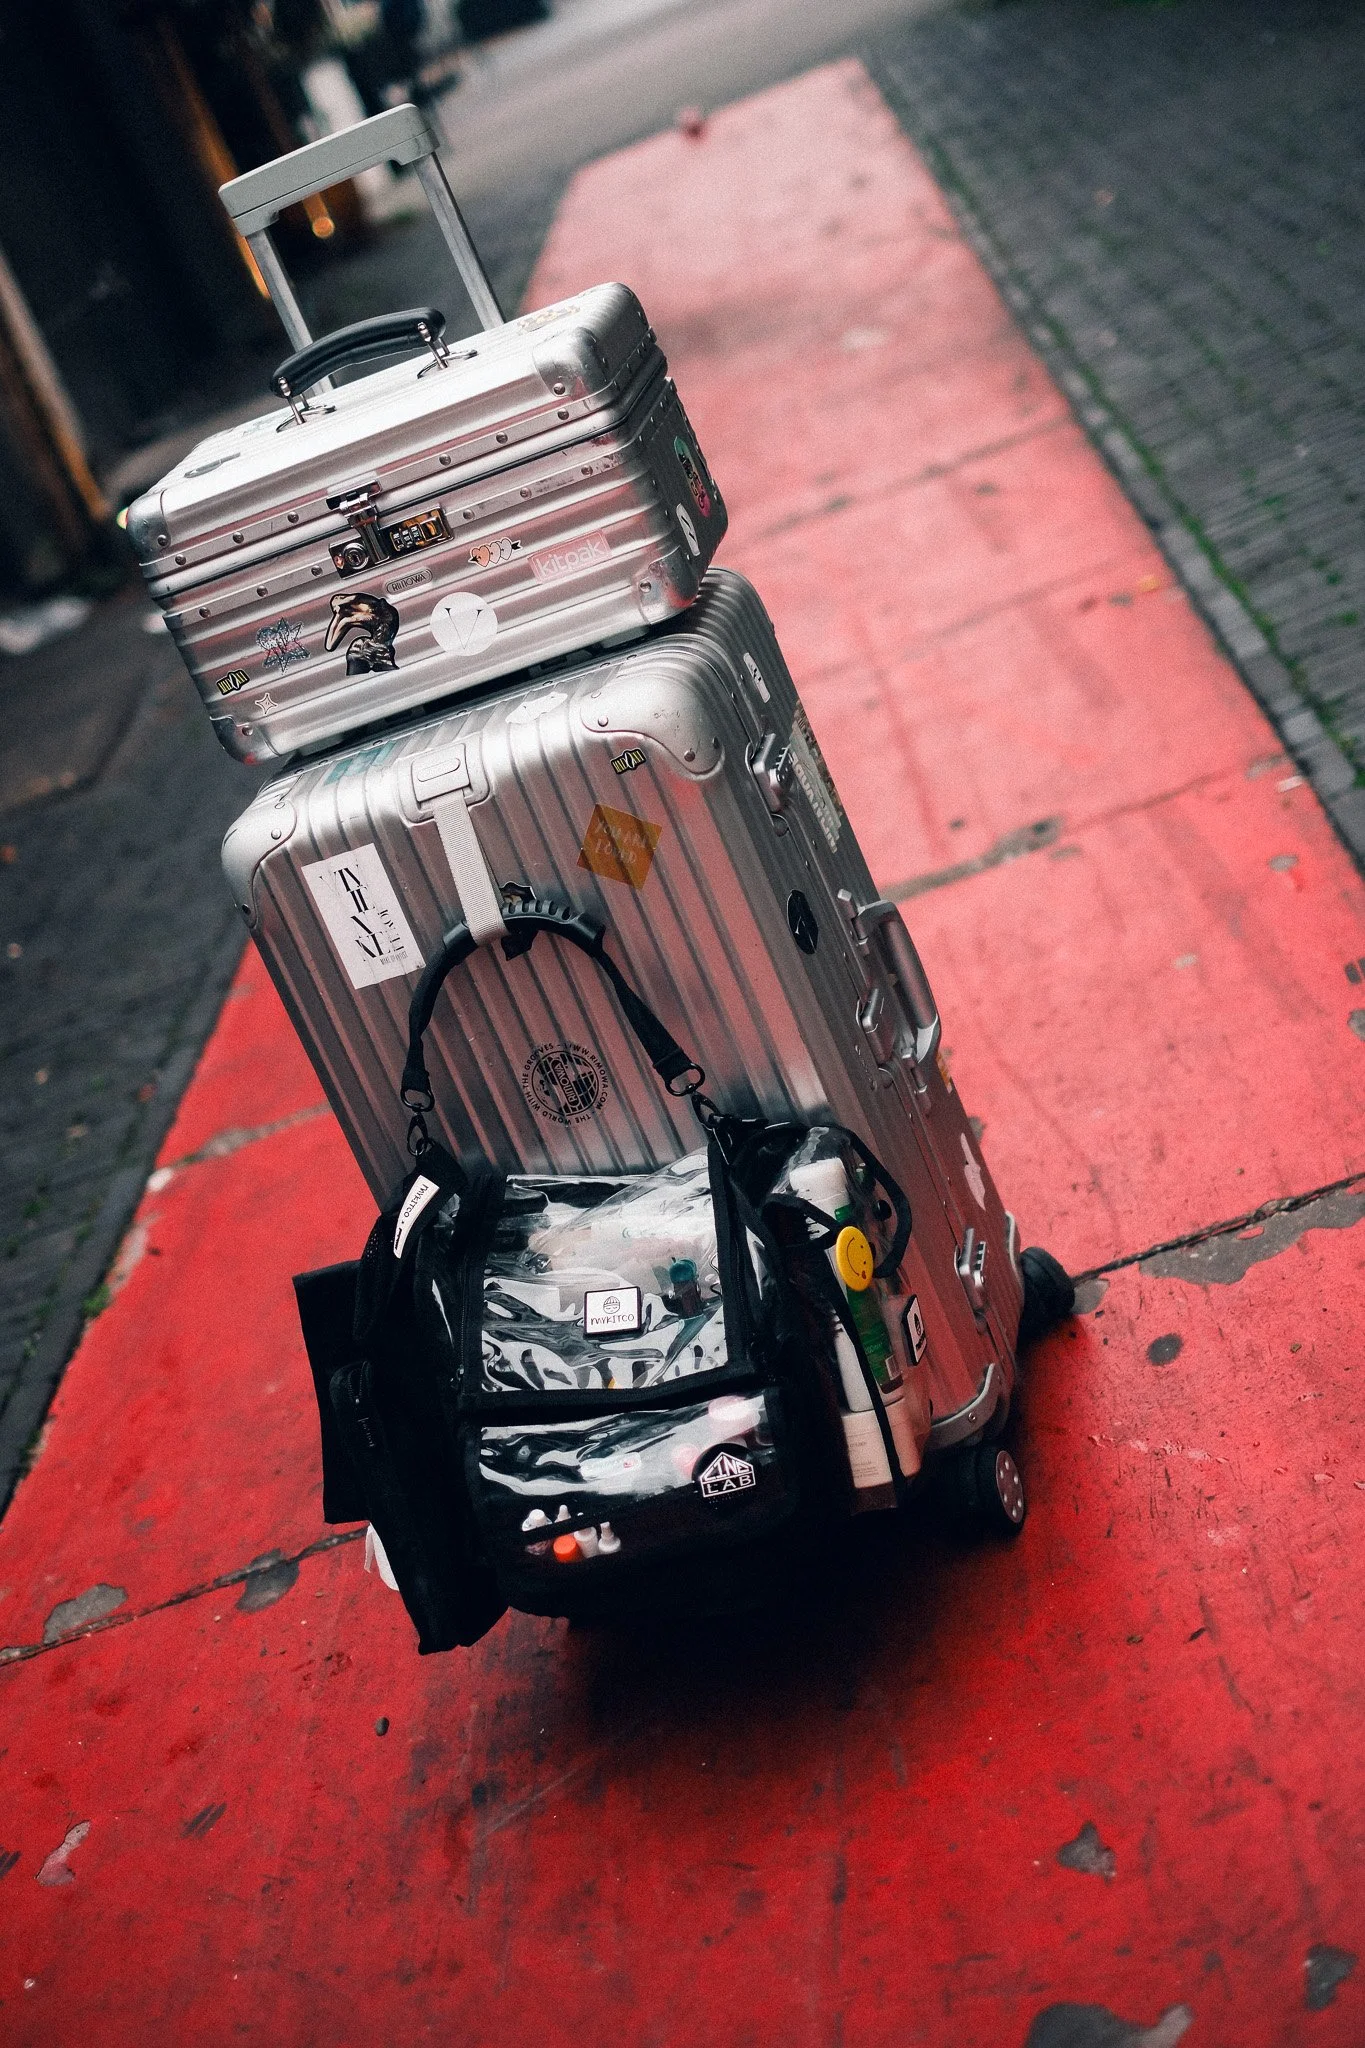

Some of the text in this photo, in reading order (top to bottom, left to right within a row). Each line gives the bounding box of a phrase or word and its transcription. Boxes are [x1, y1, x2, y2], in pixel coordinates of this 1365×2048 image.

[536, 539, 605, 576] kitpak
[392, 573, 426, 592] RIMOWA
[553, 1061, 579, 1103] RIMOWA
[525, 1091, 540, 1112] WITH
[574, 1113, 591, 1124] THE
[590, 1313, 635, 1326] MYKITCO
[707, 1475, 752, 1494] LAB
